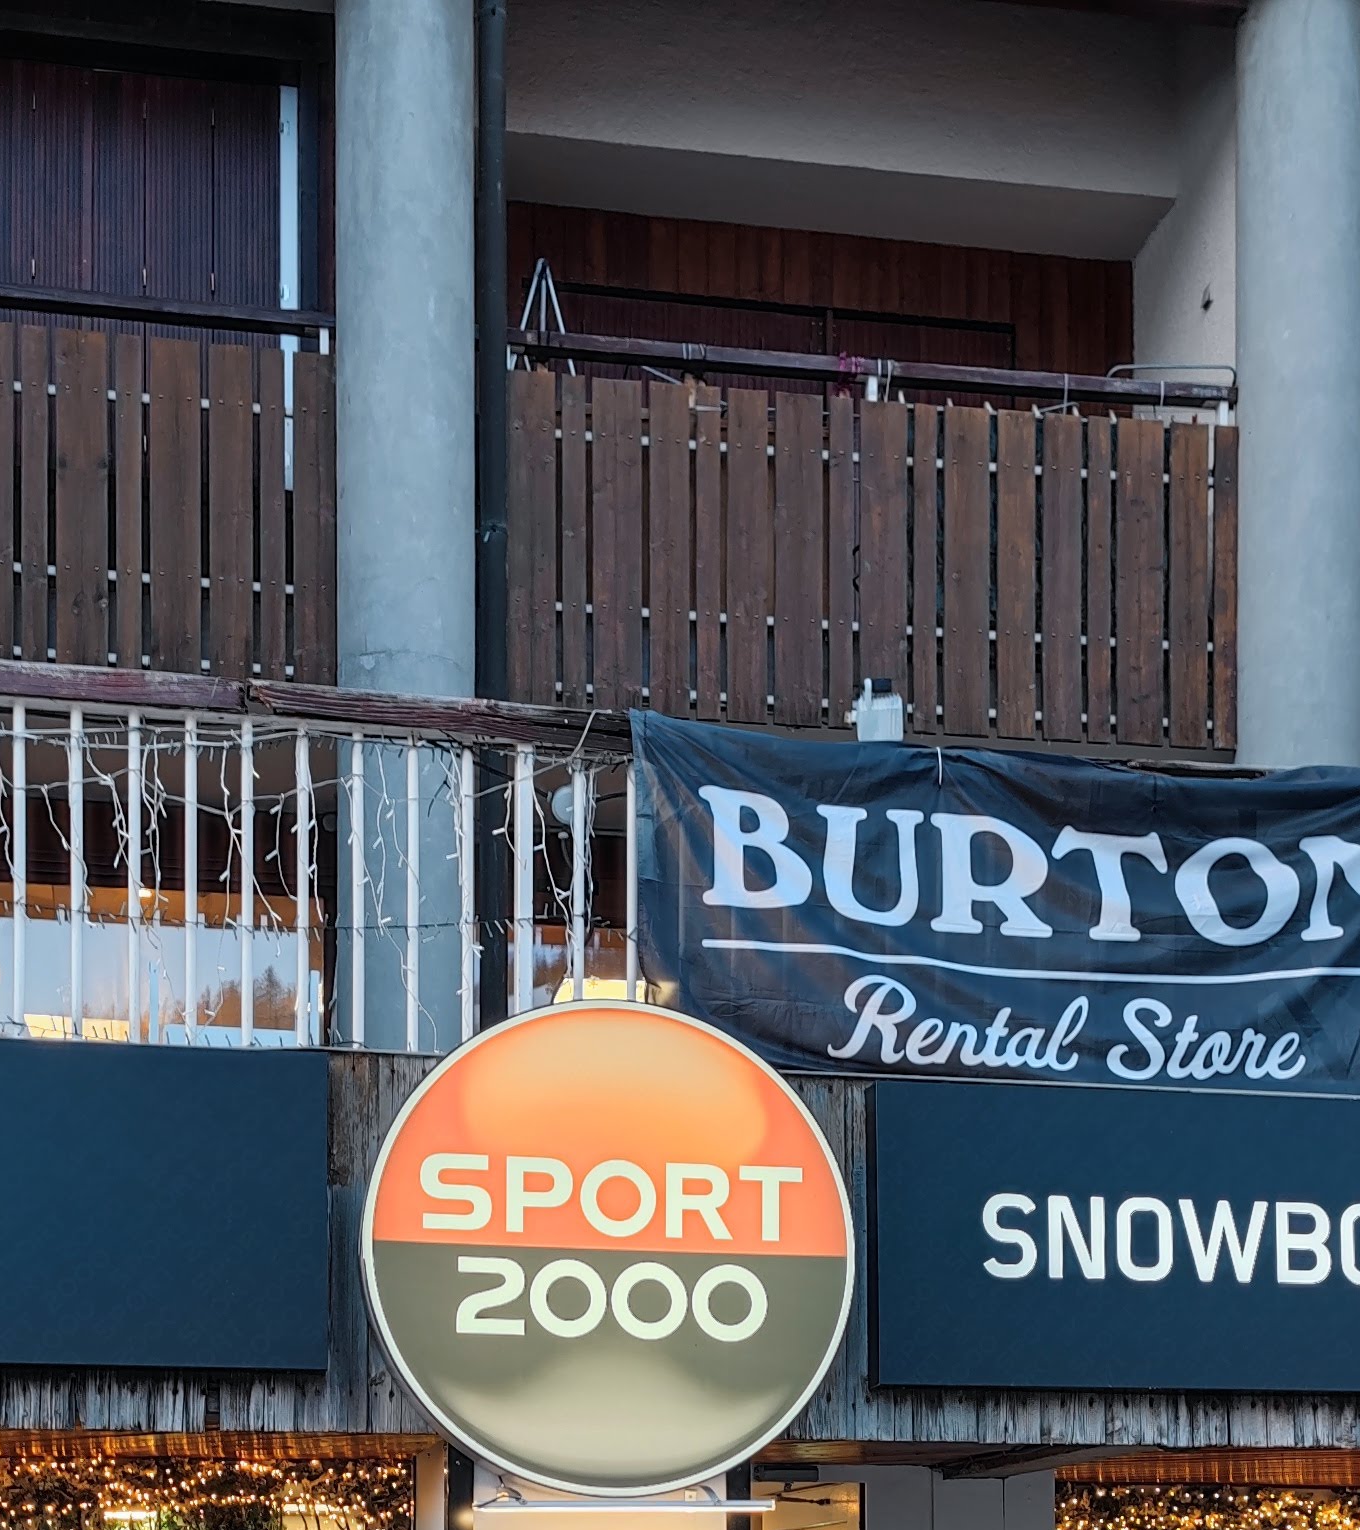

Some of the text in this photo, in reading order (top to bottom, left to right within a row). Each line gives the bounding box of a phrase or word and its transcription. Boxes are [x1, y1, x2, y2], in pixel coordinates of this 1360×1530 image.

[827, 973, 1307, 1082] Rental Store
[418, 1152, 804, 1243] SPORT
[455, 1255, 769, 1343] 2000
